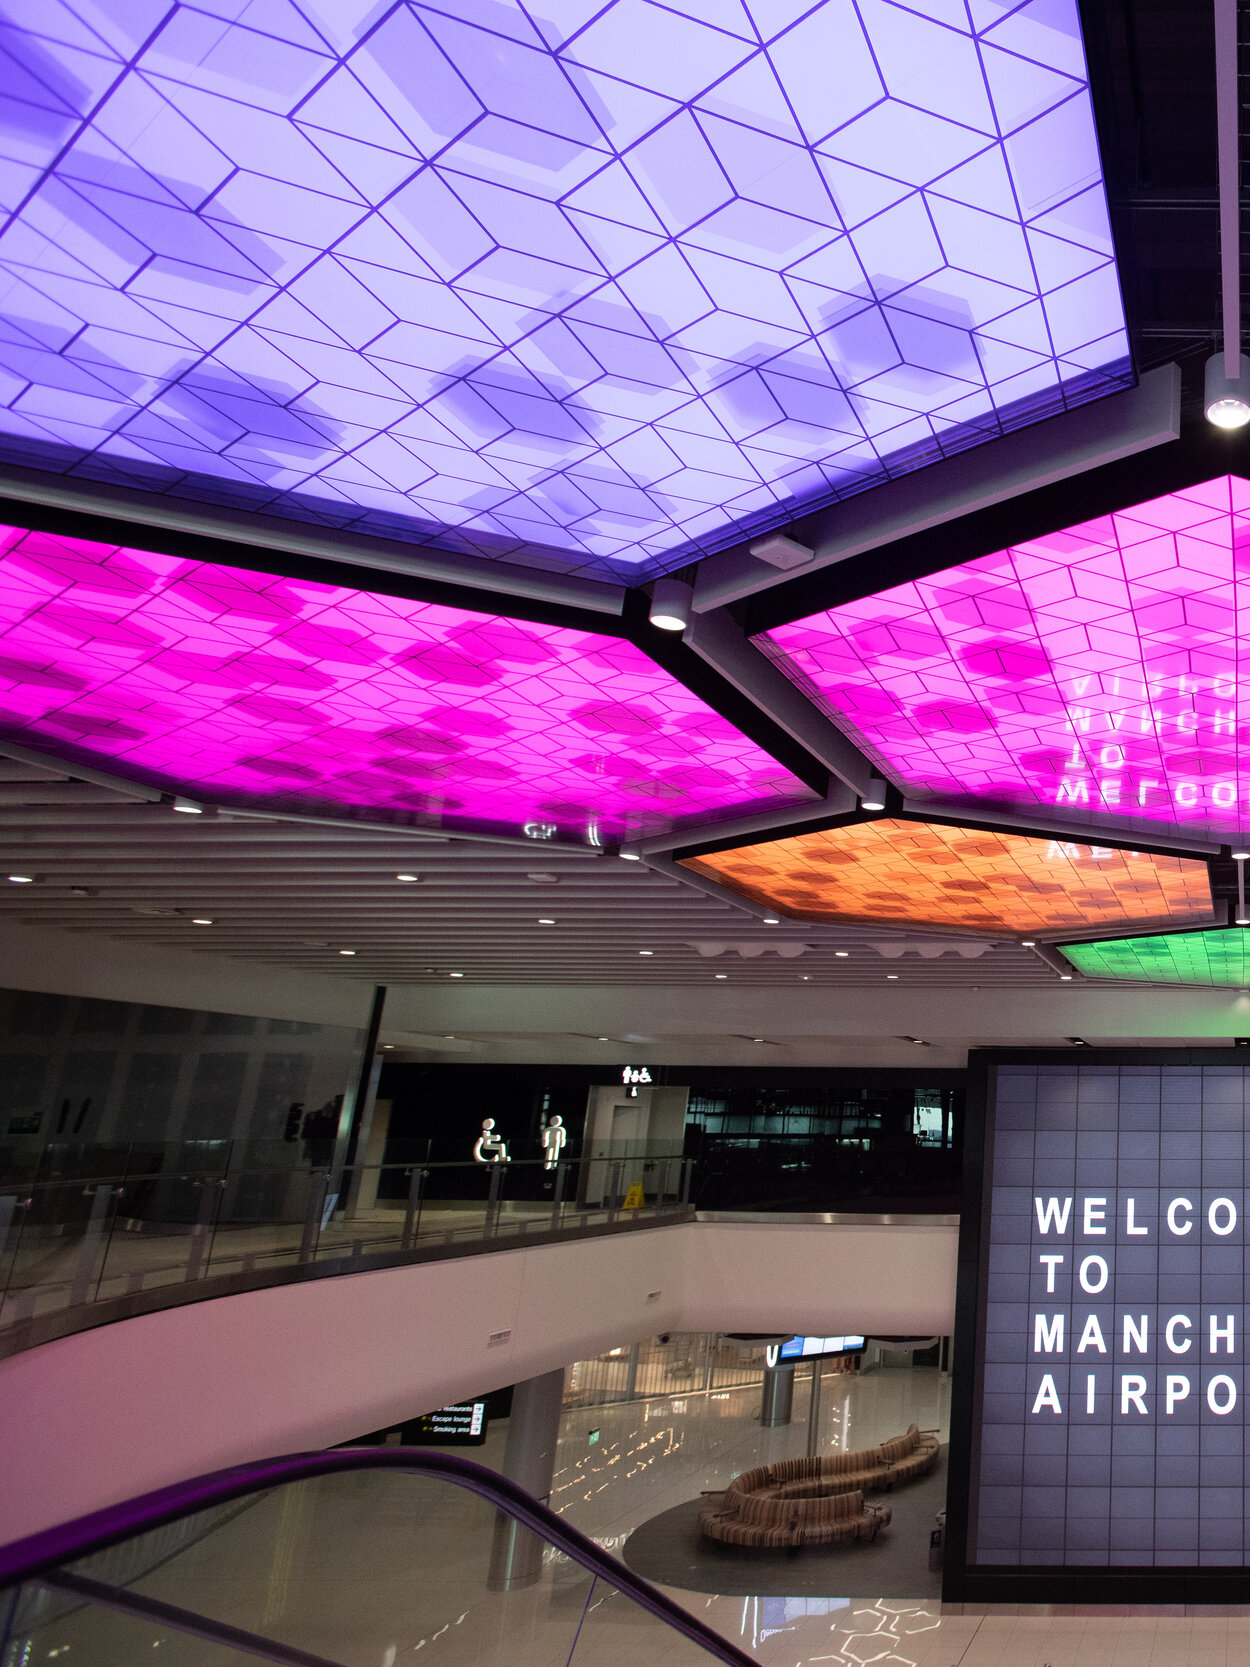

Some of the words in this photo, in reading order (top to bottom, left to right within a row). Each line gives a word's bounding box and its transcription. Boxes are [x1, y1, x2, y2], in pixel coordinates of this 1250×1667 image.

[1039, 1254, 1109, 1294] TO
[432, 1415, 453, 1423] Escape
[433, 1425, 457, 1433] Smoking
